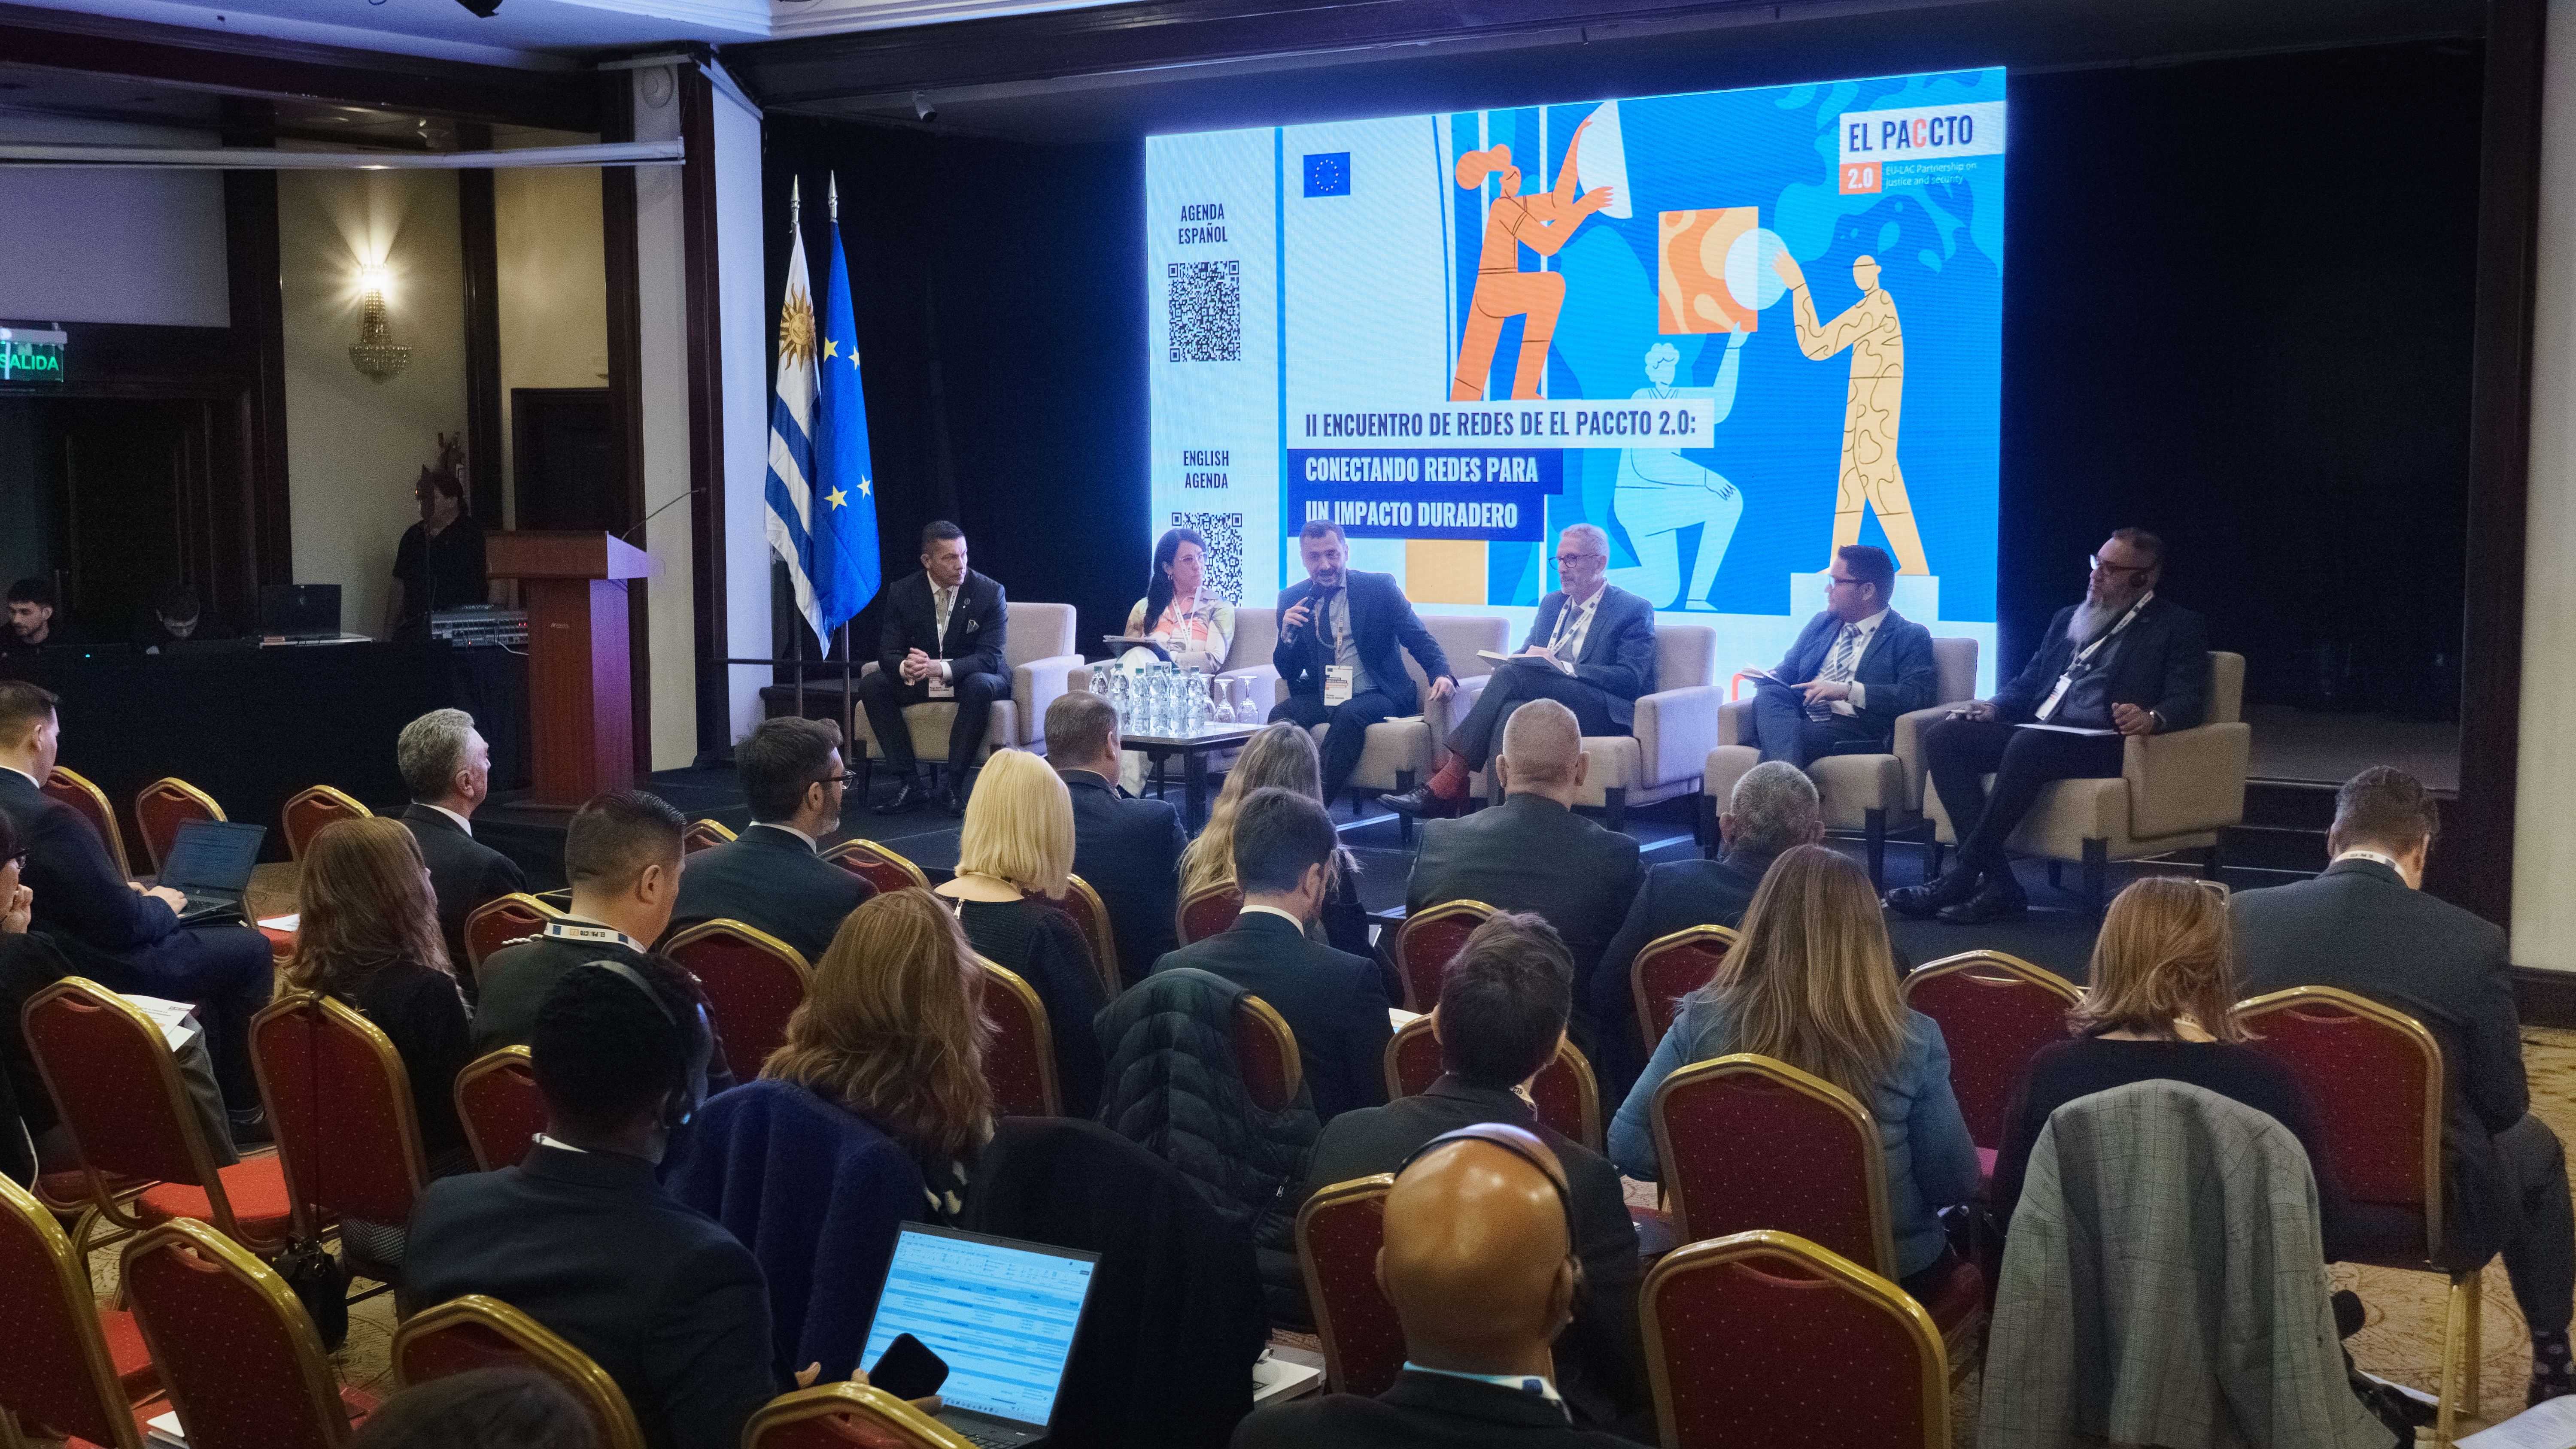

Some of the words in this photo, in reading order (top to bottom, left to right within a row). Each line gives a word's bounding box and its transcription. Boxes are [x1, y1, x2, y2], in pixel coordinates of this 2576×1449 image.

[1849, 123, 1873, 152] EL
[1882, 115, 1973, 150] PACCTO
[1847, 167, 1873, 189] 2.0
[1886, 164, 1915, 175] EU-LAC
[1917, 162, 1964, 172] Partnership
[1914, 176, 1929, 185] and
[1931, 175, 1963, 185] security
[1181, 203, 1224, 222] AGENDA
[1179, 222, 1227, 245] ESPAÑOL
[1306, 414, 1317, 437] II
[1323, 413, 1422, 437] ENCUENTRO
[1430, 412, 1451, 436] DE
[1458, 412, 1514, 436] REDES
[1521, 412, 1543, 436] DE
[1550, 411, 1569, 436] EL
[1577, 411, 1652, 436] PACCTO
[1659, 409, 1695, 436] 2.0:
[1183, 450, 1229, 466] ENGLISH
[1185, 473, 1228, 488] AGENDA
[1306, 457, 1419, 482] CONECTANDO
[1424, 457, 1481, 482] REDES
[1486, 457, 1539, 482] PARA
[1334, 501, 1413, 527] IMPACTO
[1418, 502, 1518, 528] DURADERO
